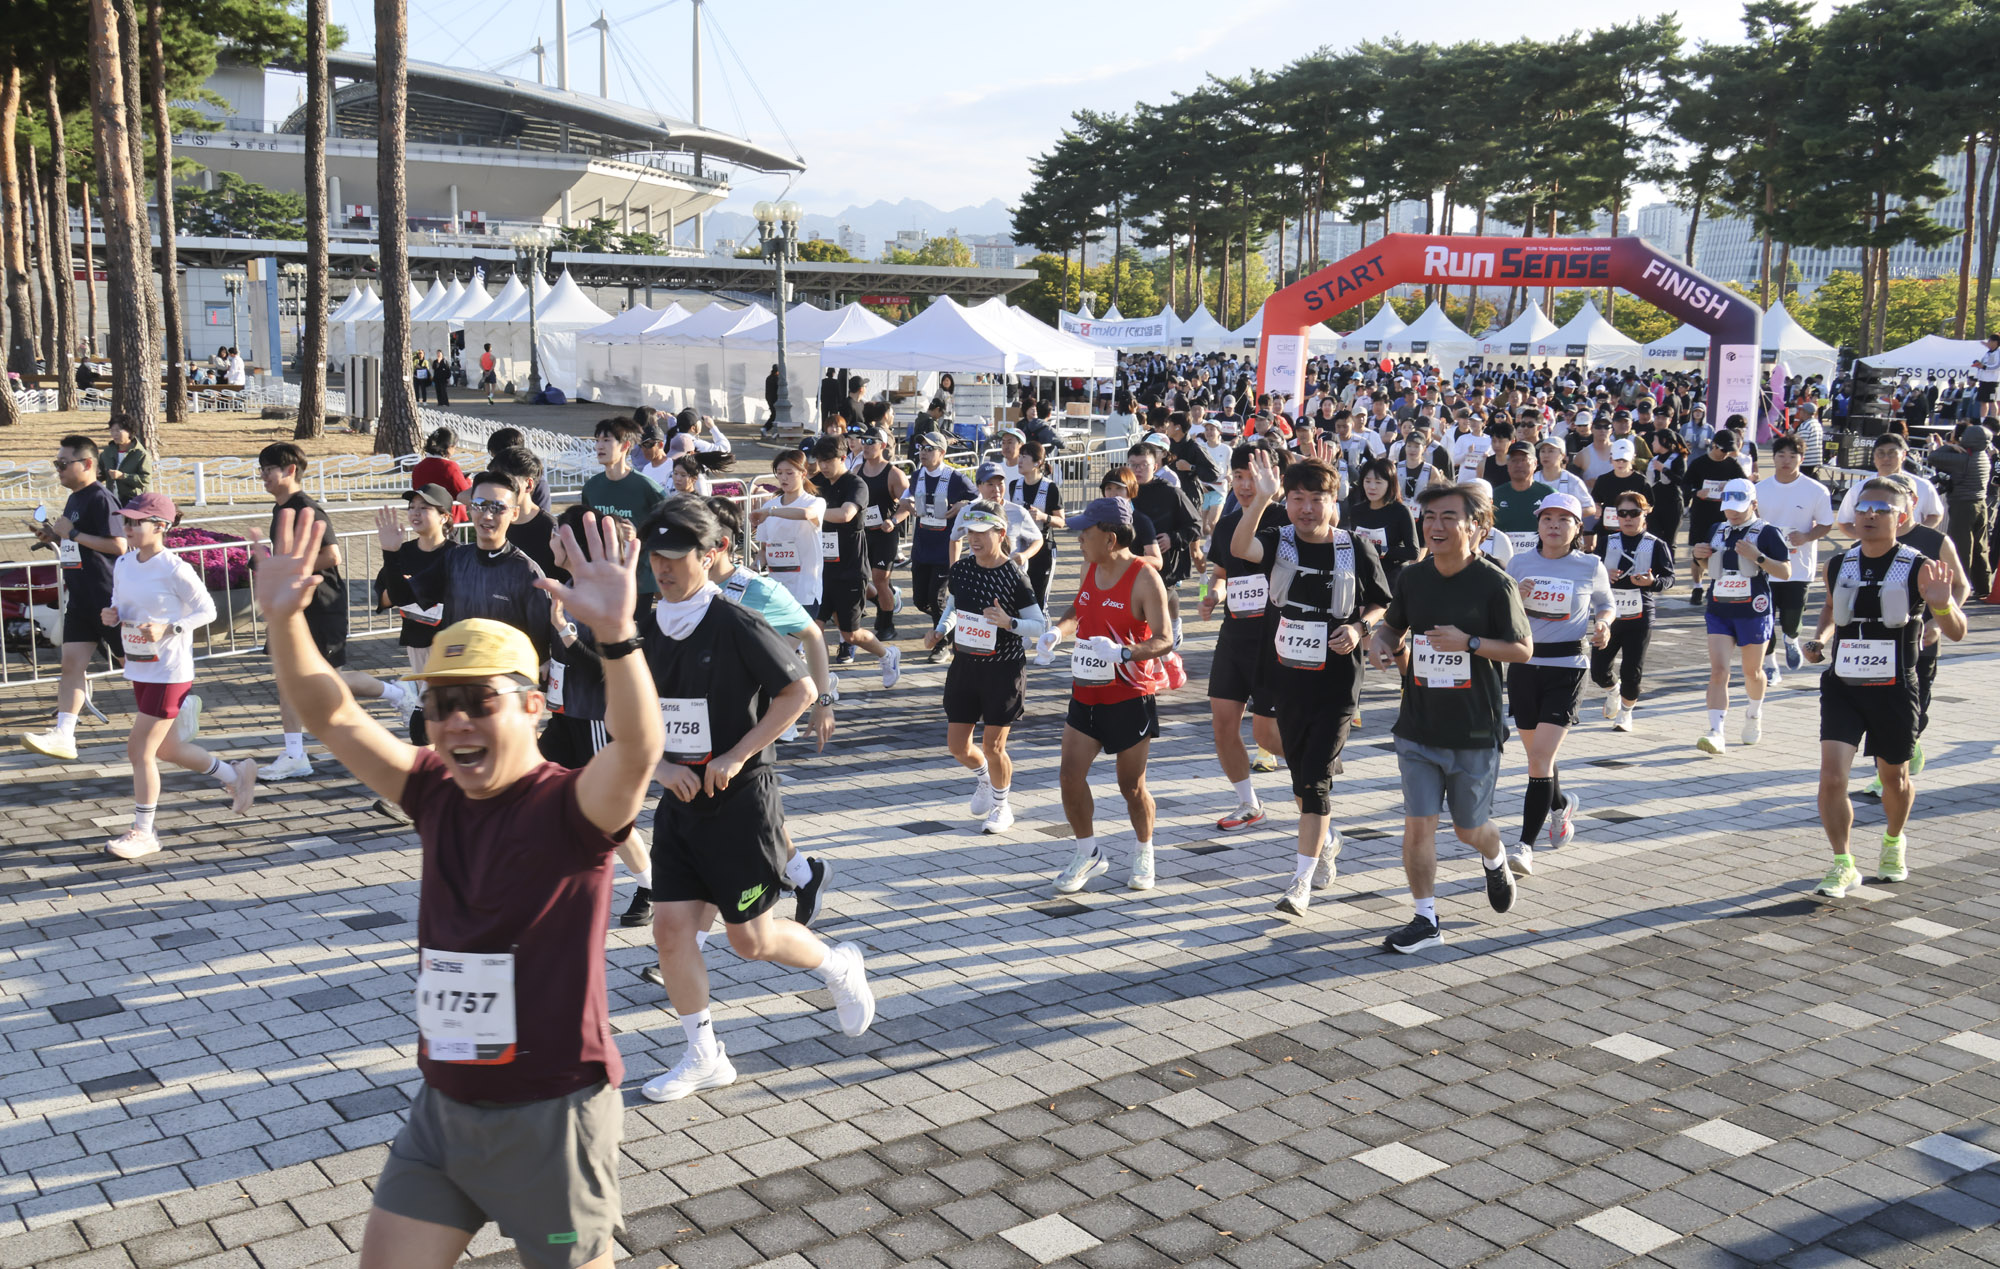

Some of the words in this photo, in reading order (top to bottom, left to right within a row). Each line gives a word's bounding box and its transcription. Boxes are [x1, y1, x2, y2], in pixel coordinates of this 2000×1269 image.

[1303, 255, 1385, 311] START
[1641, 259, 1730, 320] FINISH
[1723, 580, 1747, 588] 2225
[1231, 592, 1236, 600] M
[1238, 588, 1264, 600] 1535
[1533, 590, 1566, 602] 2319
[965, 626, 991, 639] 2506
[1279, 634, 1285, 643] M
[1288, 635, 1321, 649] 1742
[1414, 638, 1426, 646] Run
[1080, 655, 1107, 668] 1620
[1418, 653, 1426, 662] M
[1429, 653, 1463, 666] 1759
[1853, 655, 1888, 666] 1324
[665, 721, 700, 734] 1758
[741, 883, 763, 902] RUN
[436, 989, 499, 1014] 1757
